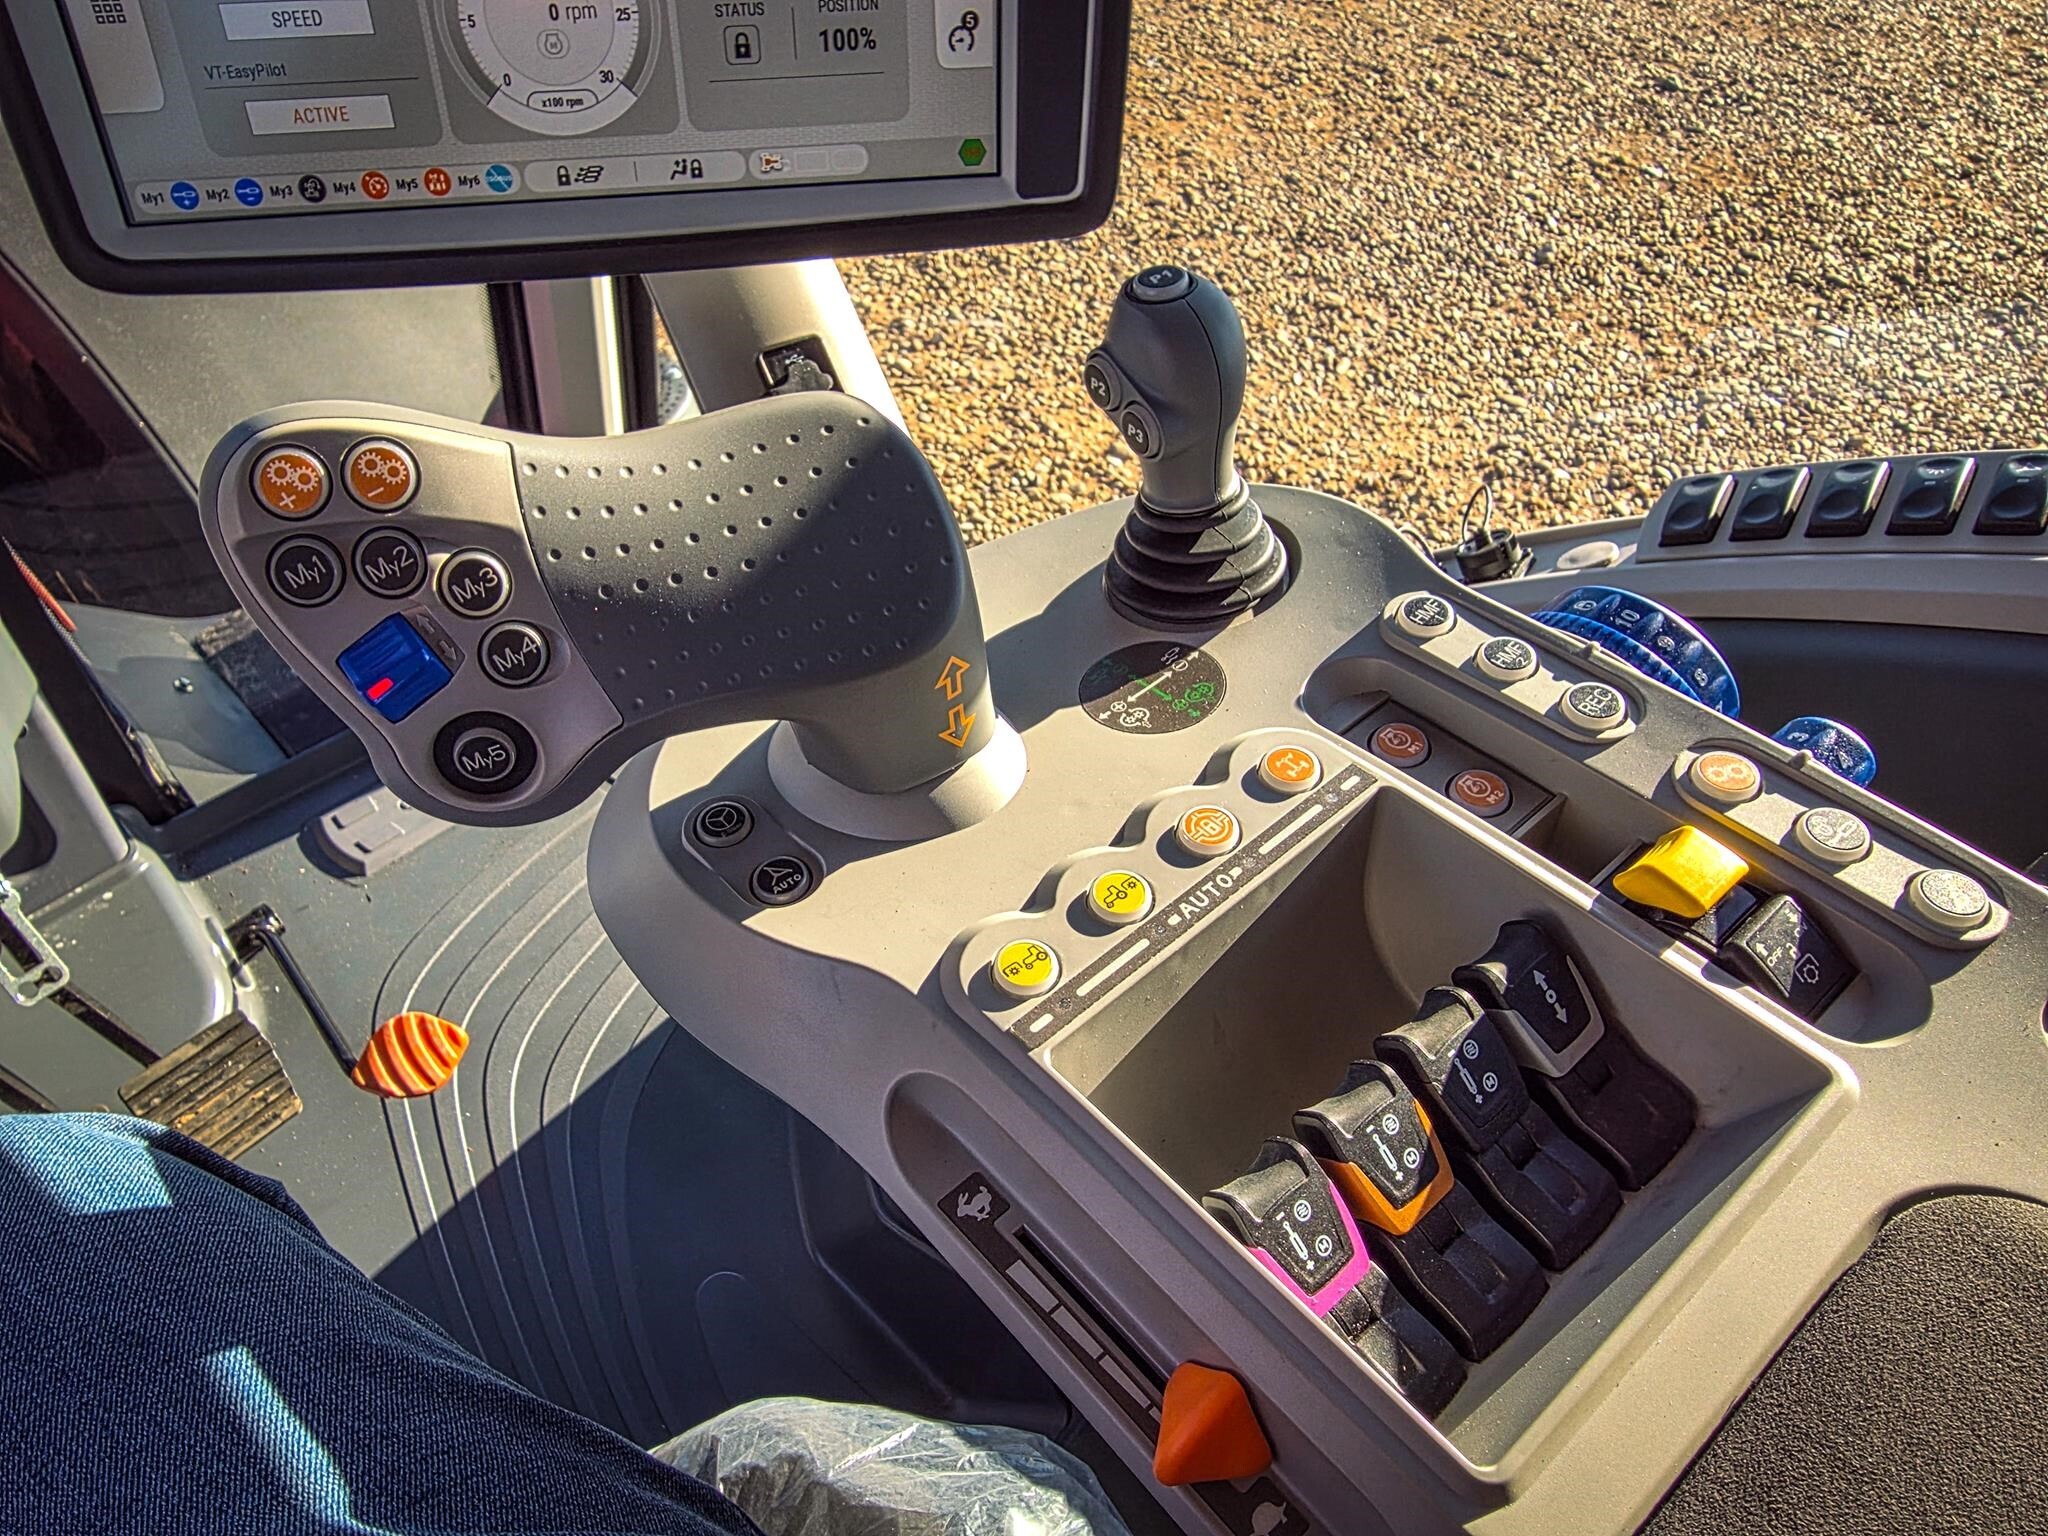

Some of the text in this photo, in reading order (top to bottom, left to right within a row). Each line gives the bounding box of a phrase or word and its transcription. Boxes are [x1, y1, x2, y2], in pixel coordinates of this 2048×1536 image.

[549, 4, 598, 24] 0 rpm
[616, 8, 631, 21] 25
[715, 2, 765, 18] STATUS
[819, 0, 879, 13] POSITION
[272, 10, 322, 28] SPEED
[467, 15, 476, 28] 5
[819, 27, 877, 52] 100%
[204, 63, 287, 81] VT-EasyPilot
[503, 74, 511, 87] 0
[600, 70, 614, 84] 30
[542, 98, 584, 109] x100 rpm
[294, 106, 350, 124] ACTIVE
[141, 192, 165, 206] My1
[206, 188, 230, 202] My2
[269, 185, 293, 198] My3
[333, 182, 356, 195] My4
[396, 178, 418, 191] My5
[458, 175, 480, 188] My6
[1090, 377, 1106, 396] P2
[1127, 423, 1144, 443] P3
[283, 555, 326, 589] My1
[365, 545, 415, 583] My2
[451, 567, 498, 604] My3
[1409, 598, 1441, 624] HMF
[1615, 609, 1641, 628] 10
[492, 636, 537, 672] My4
[1490, 641, 1522, 668] HMF
[1577, 689, 1612, 715] REC
[461, 744, 506, 772] My5
[1486, 790, 1505, 804] M2
[772, 873, 801, 894] AUTO
[1179, 874, 1233, 919] AUTO
[1767, 946, 1783, 967] OFF
